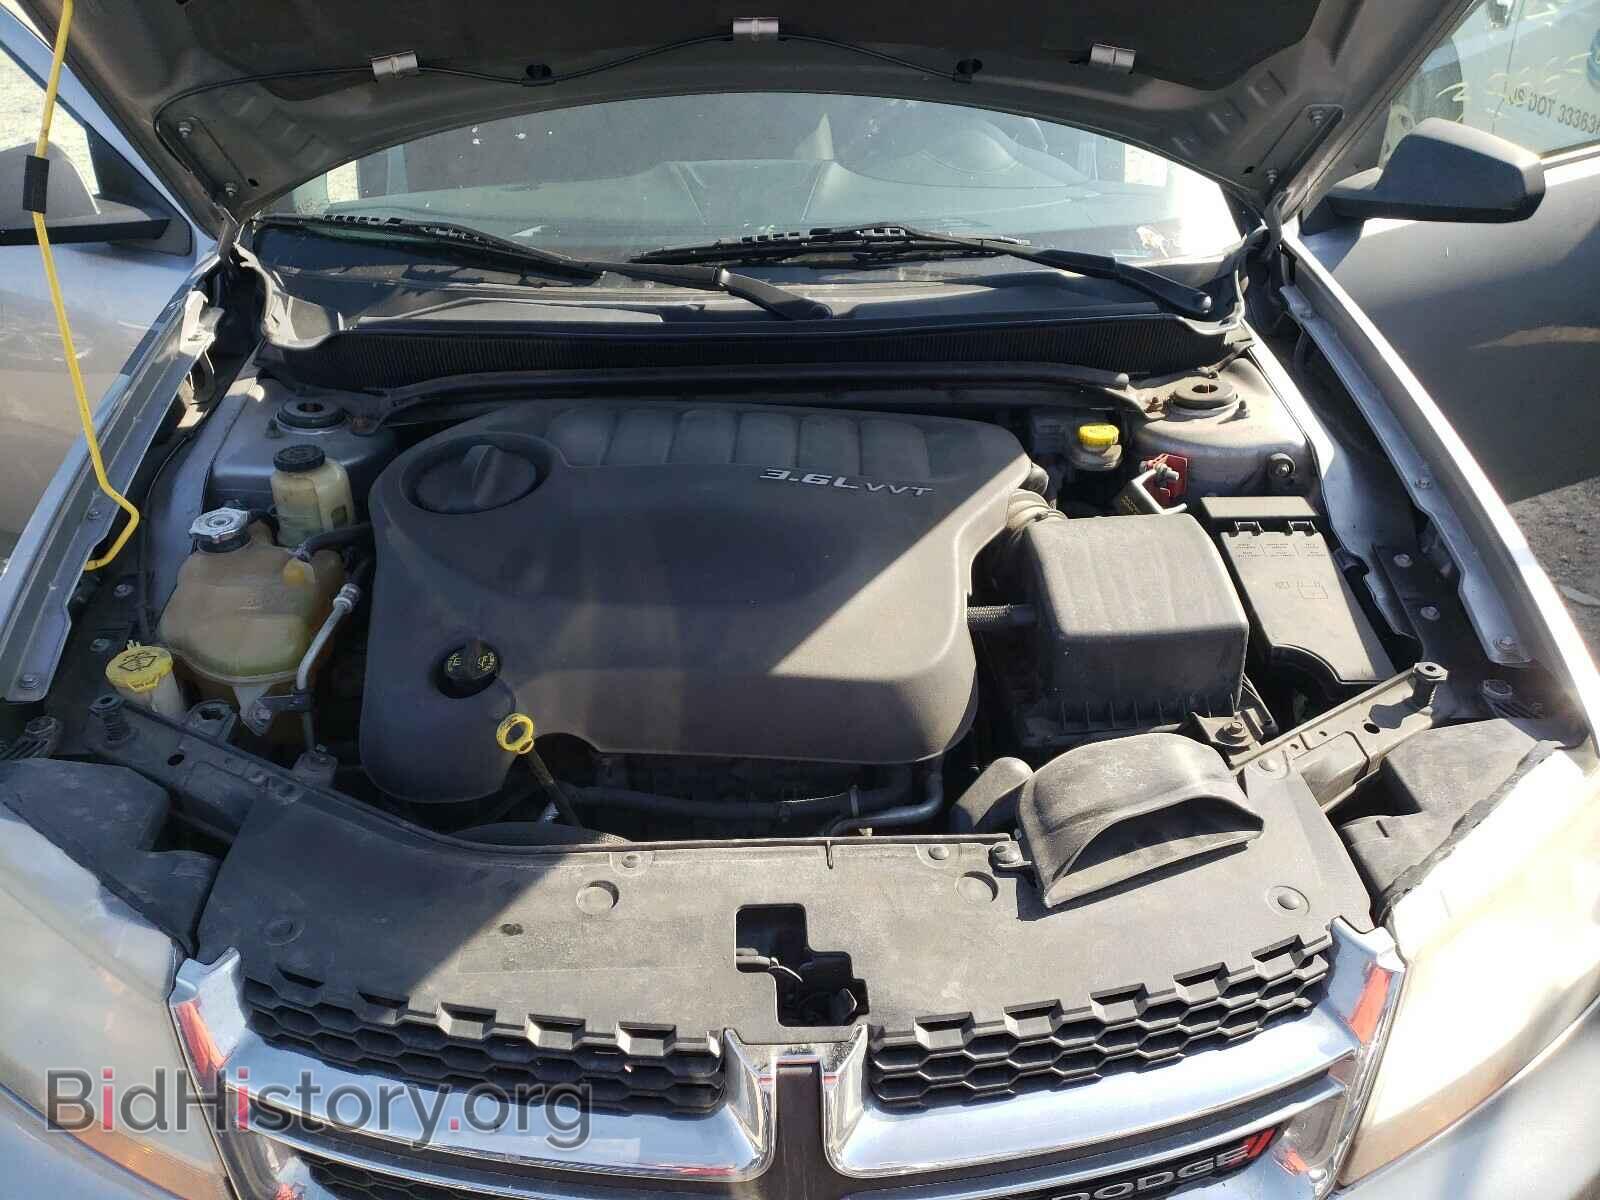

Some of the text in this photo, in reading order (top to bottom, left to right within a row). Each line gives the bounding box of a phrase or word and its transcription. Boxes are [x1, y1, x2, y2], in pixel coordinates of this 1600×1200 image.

[1528, 92, 1556, 118] DOT
[759, 468, 936, 497] 3.6L VVT
